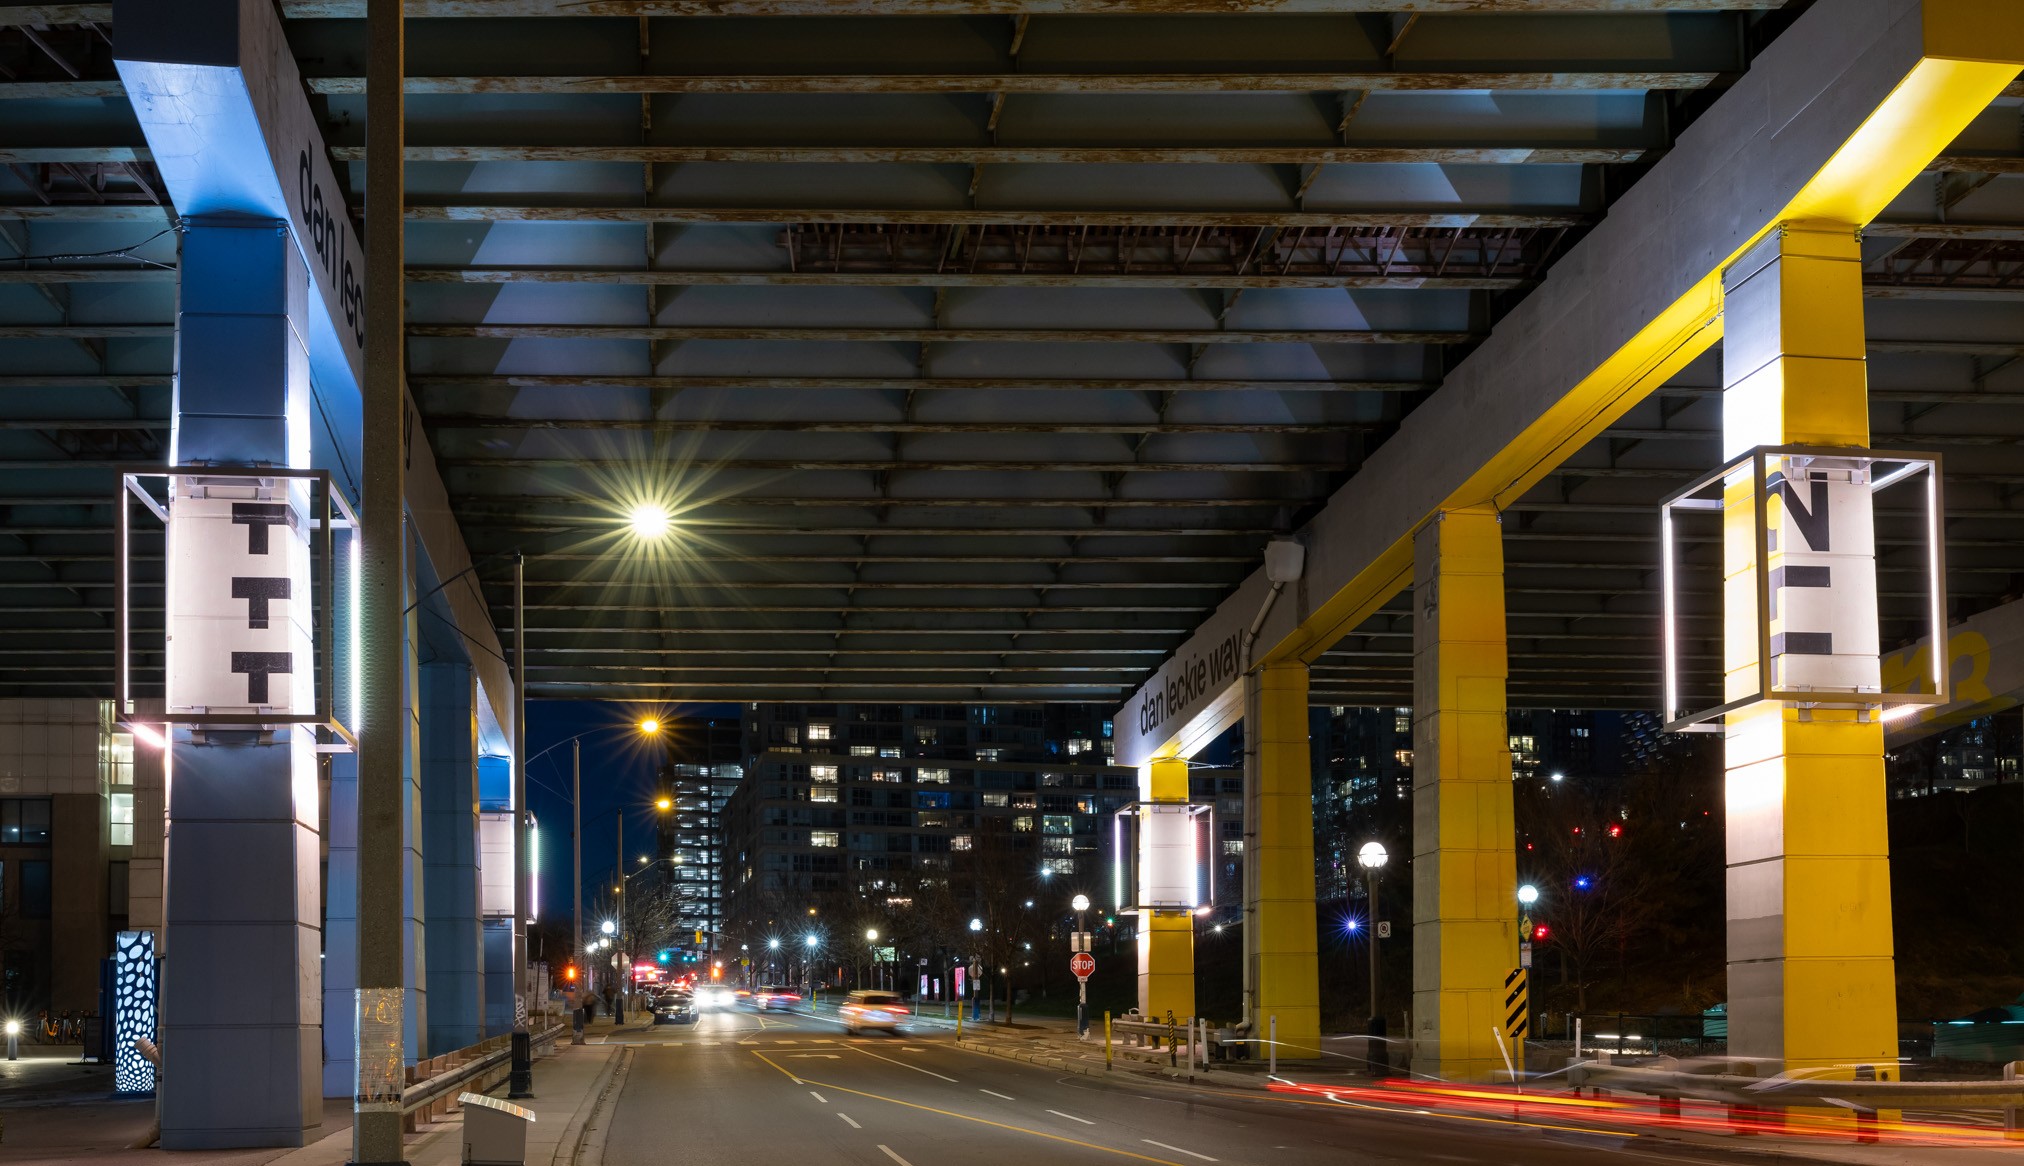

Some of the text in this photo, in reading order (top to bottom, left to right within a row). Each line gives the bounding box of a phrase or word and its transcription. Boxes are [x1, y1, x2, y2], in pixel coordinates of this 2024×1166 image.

[300, 139, 364, 350] dan lec
[1140, 628, 1243, 736] dan leckie way
[1072, 960, 1094, 970] STOP
